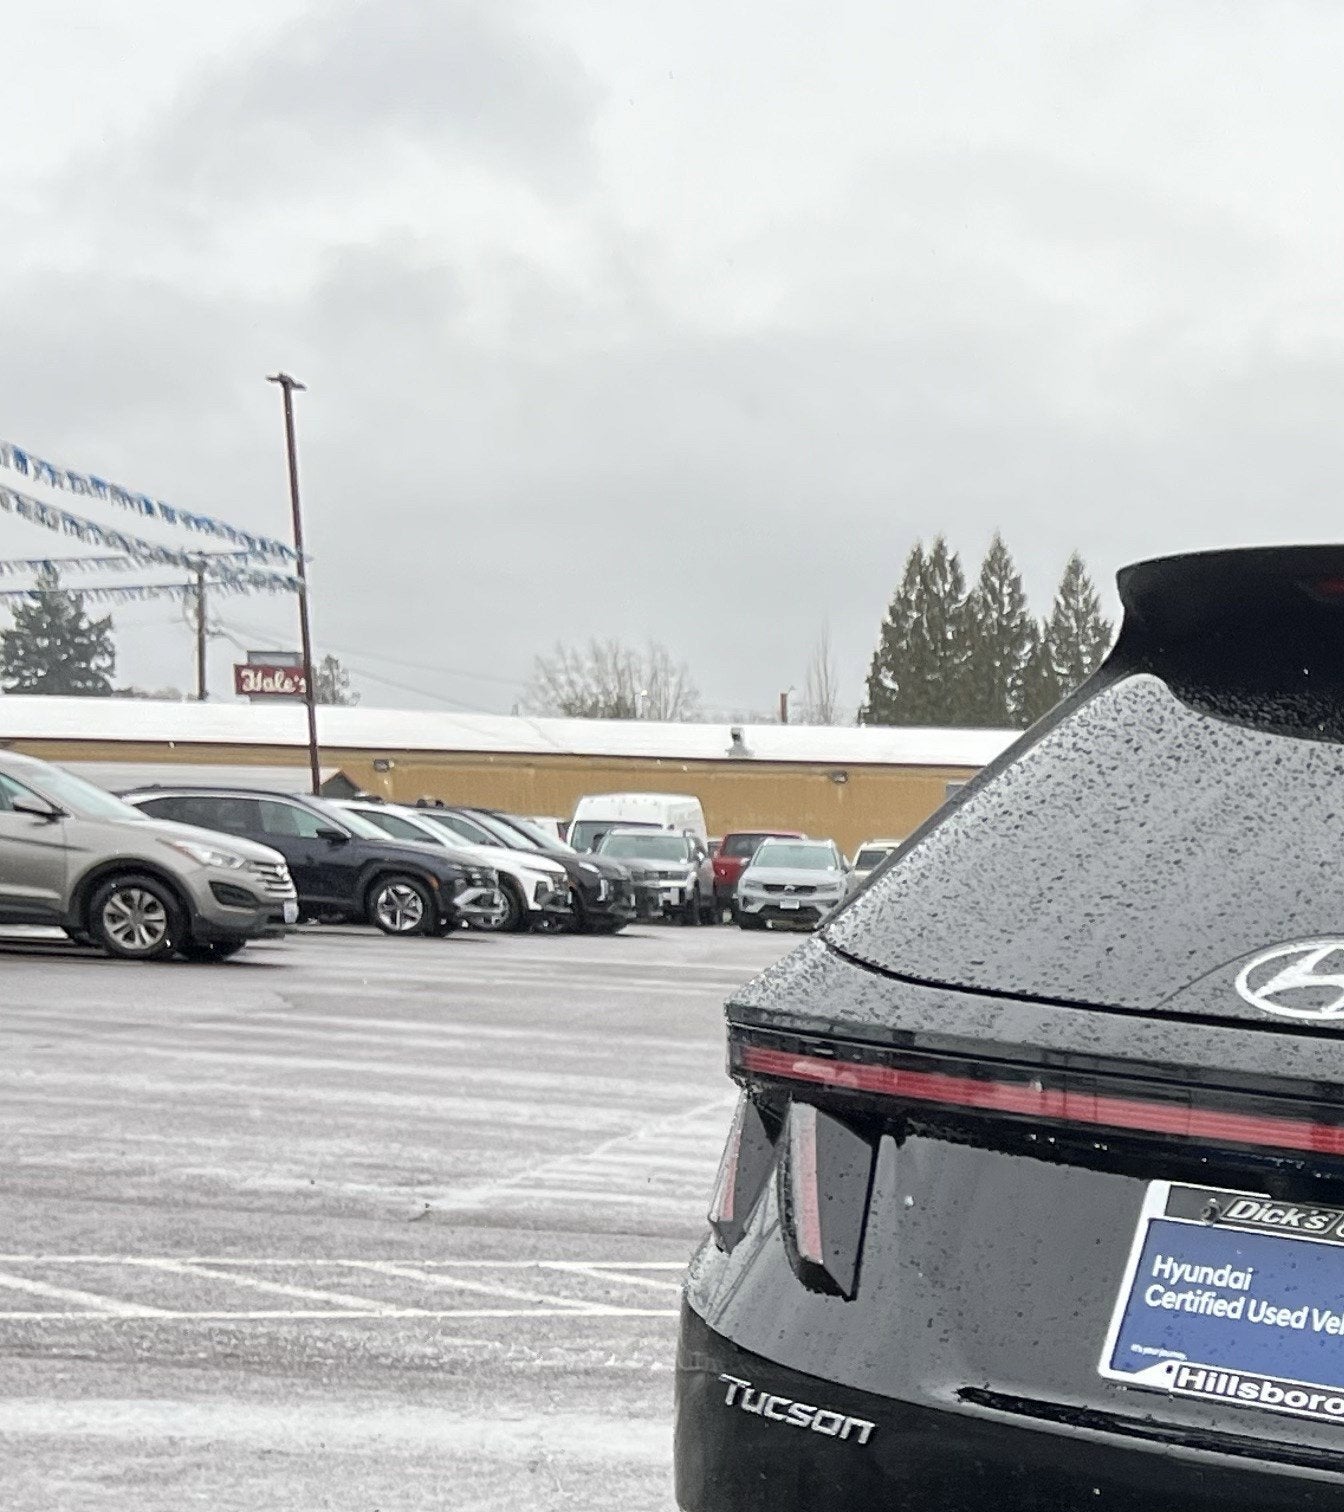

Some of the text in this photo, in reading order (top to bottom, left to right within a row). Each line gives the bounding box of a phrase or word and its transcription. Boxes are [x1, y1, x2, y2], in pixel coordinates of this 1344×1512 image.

[1227, 1200, 1330, 1230] Dick's
[1151, 1254, 1253, 1291] Hyundai
[1144, 1284, 1246, 1320] Certified
[1247, 1299, 1310, 1330] Used
